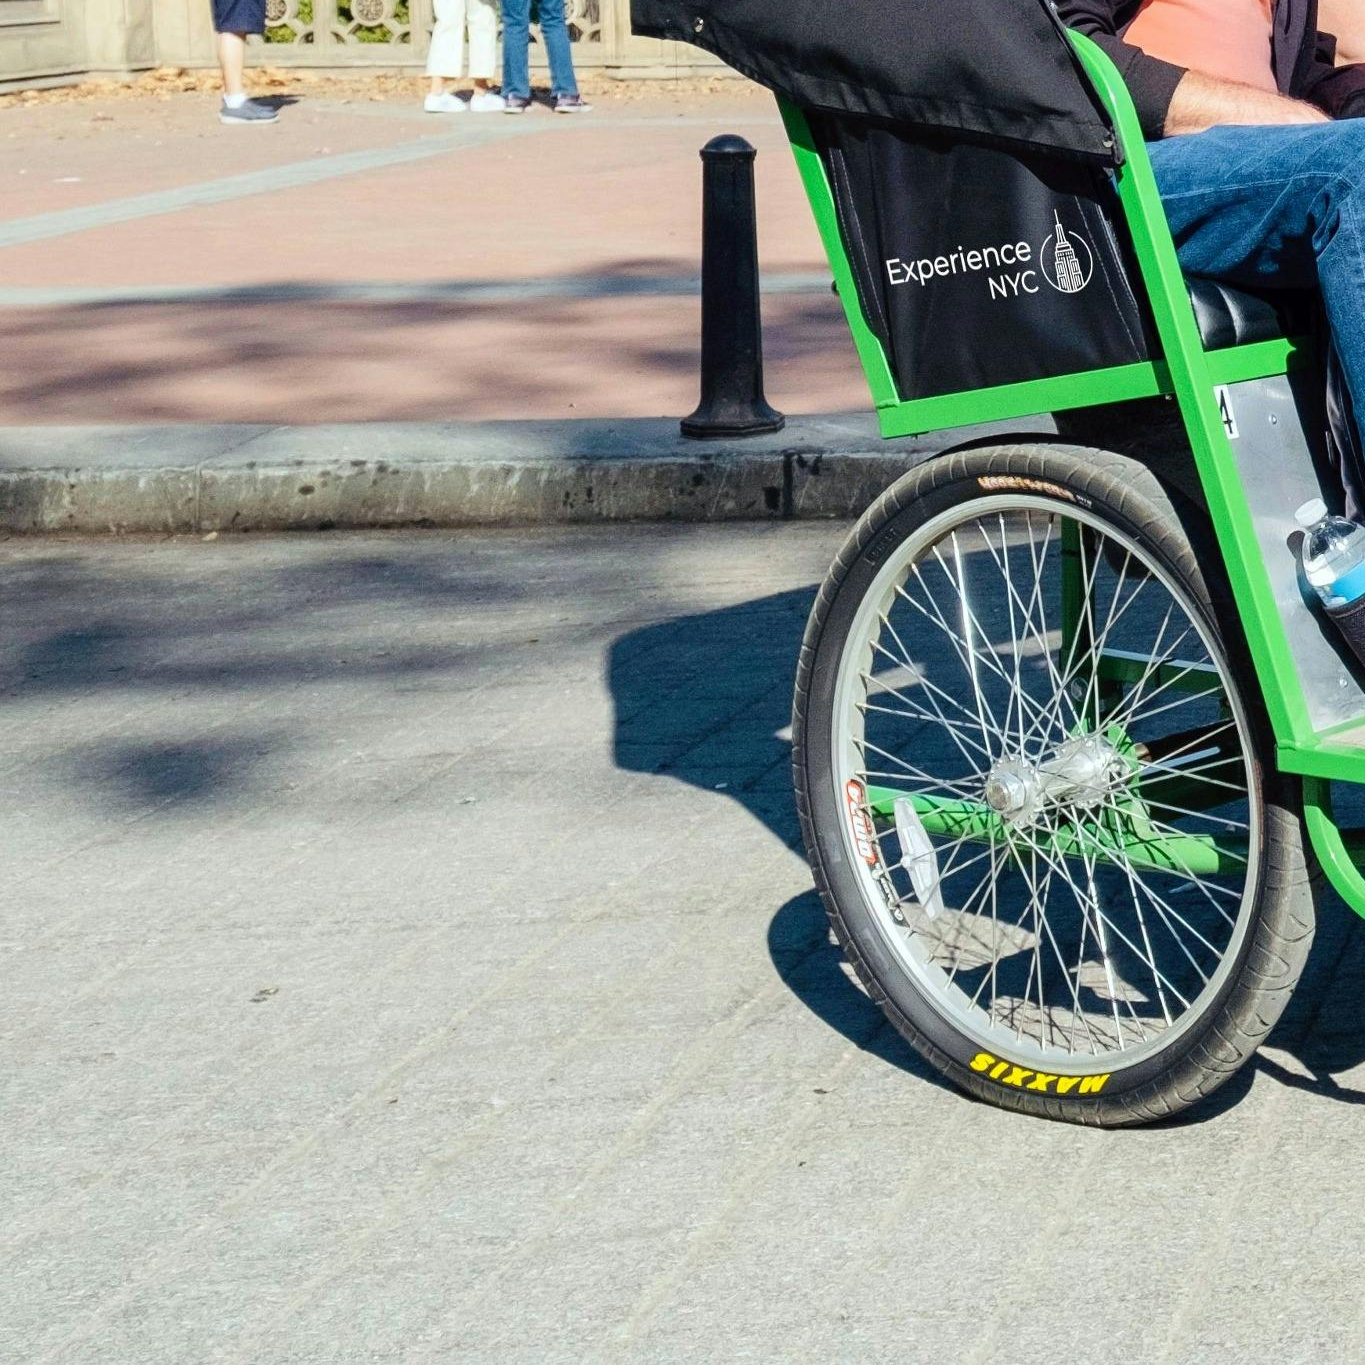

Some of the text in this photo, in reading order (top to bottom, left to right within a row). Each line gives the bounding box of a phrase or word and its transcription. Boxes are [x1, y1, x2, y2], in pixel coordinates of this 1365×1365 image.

[886, 238, 1032, 287] Experience
[988, 270, 1040, 300] NYC
[969, 1050, 1111, 1095] MAXXIS
